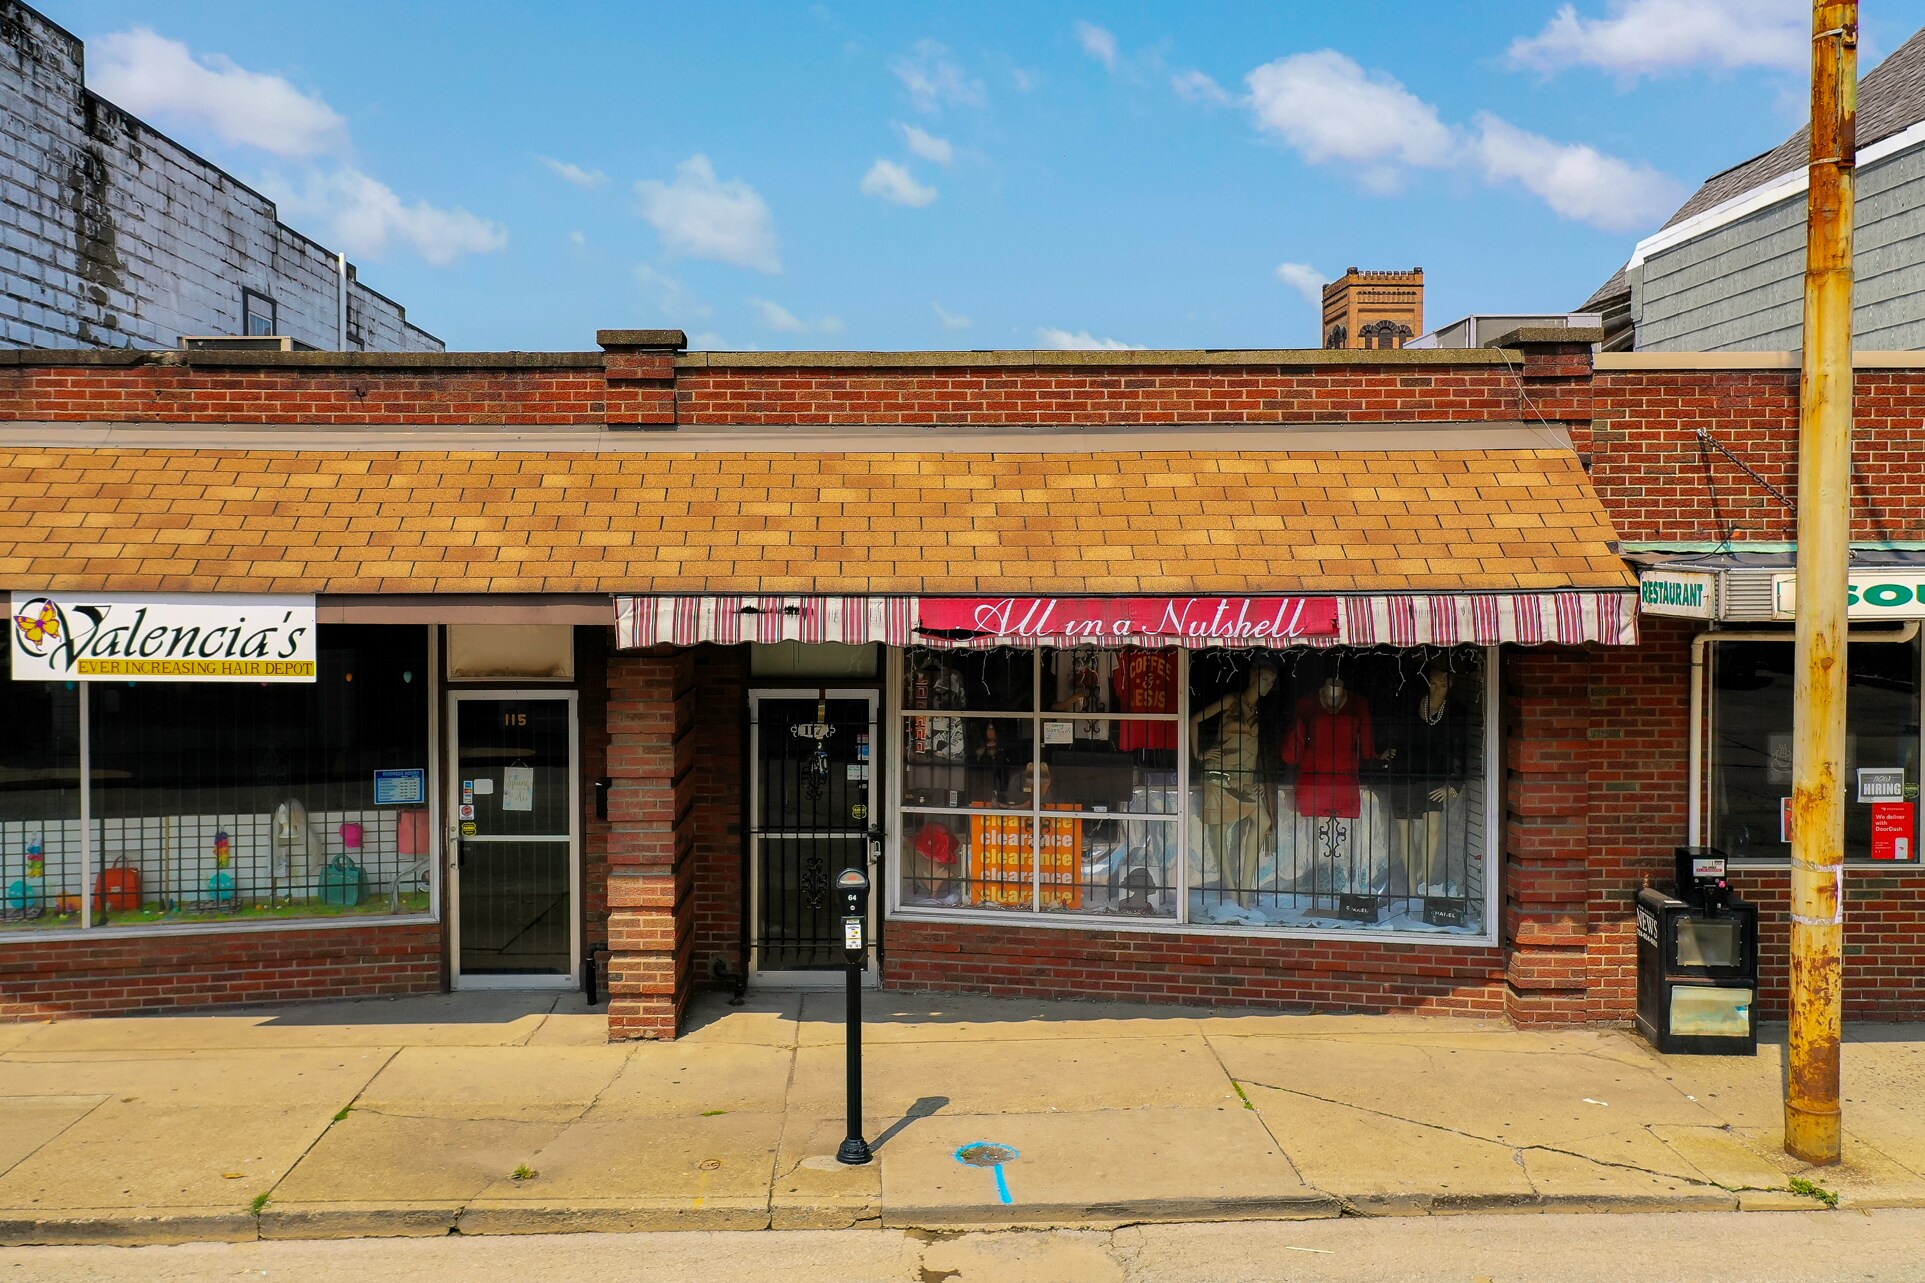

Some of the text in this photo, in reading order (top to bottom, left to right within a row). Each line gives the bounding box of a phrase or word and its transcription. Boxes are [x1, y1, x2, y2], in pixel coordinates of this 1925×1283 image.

[1641, 580, 1704, 608] RESTAURANT
[973, 598, 1306, 638] All in a Nutshell
[15, 597, 307, 673] Valencia's
[77, 660, 314, 676] EVER INCREASING HAIR DEPOT
[504, 713, 527, 726] 115
[1863, 783, 1902, 795] HIRING
[980, 815, 1073, 828] clearce
[1636, 907, 1658, 939] NEWS
